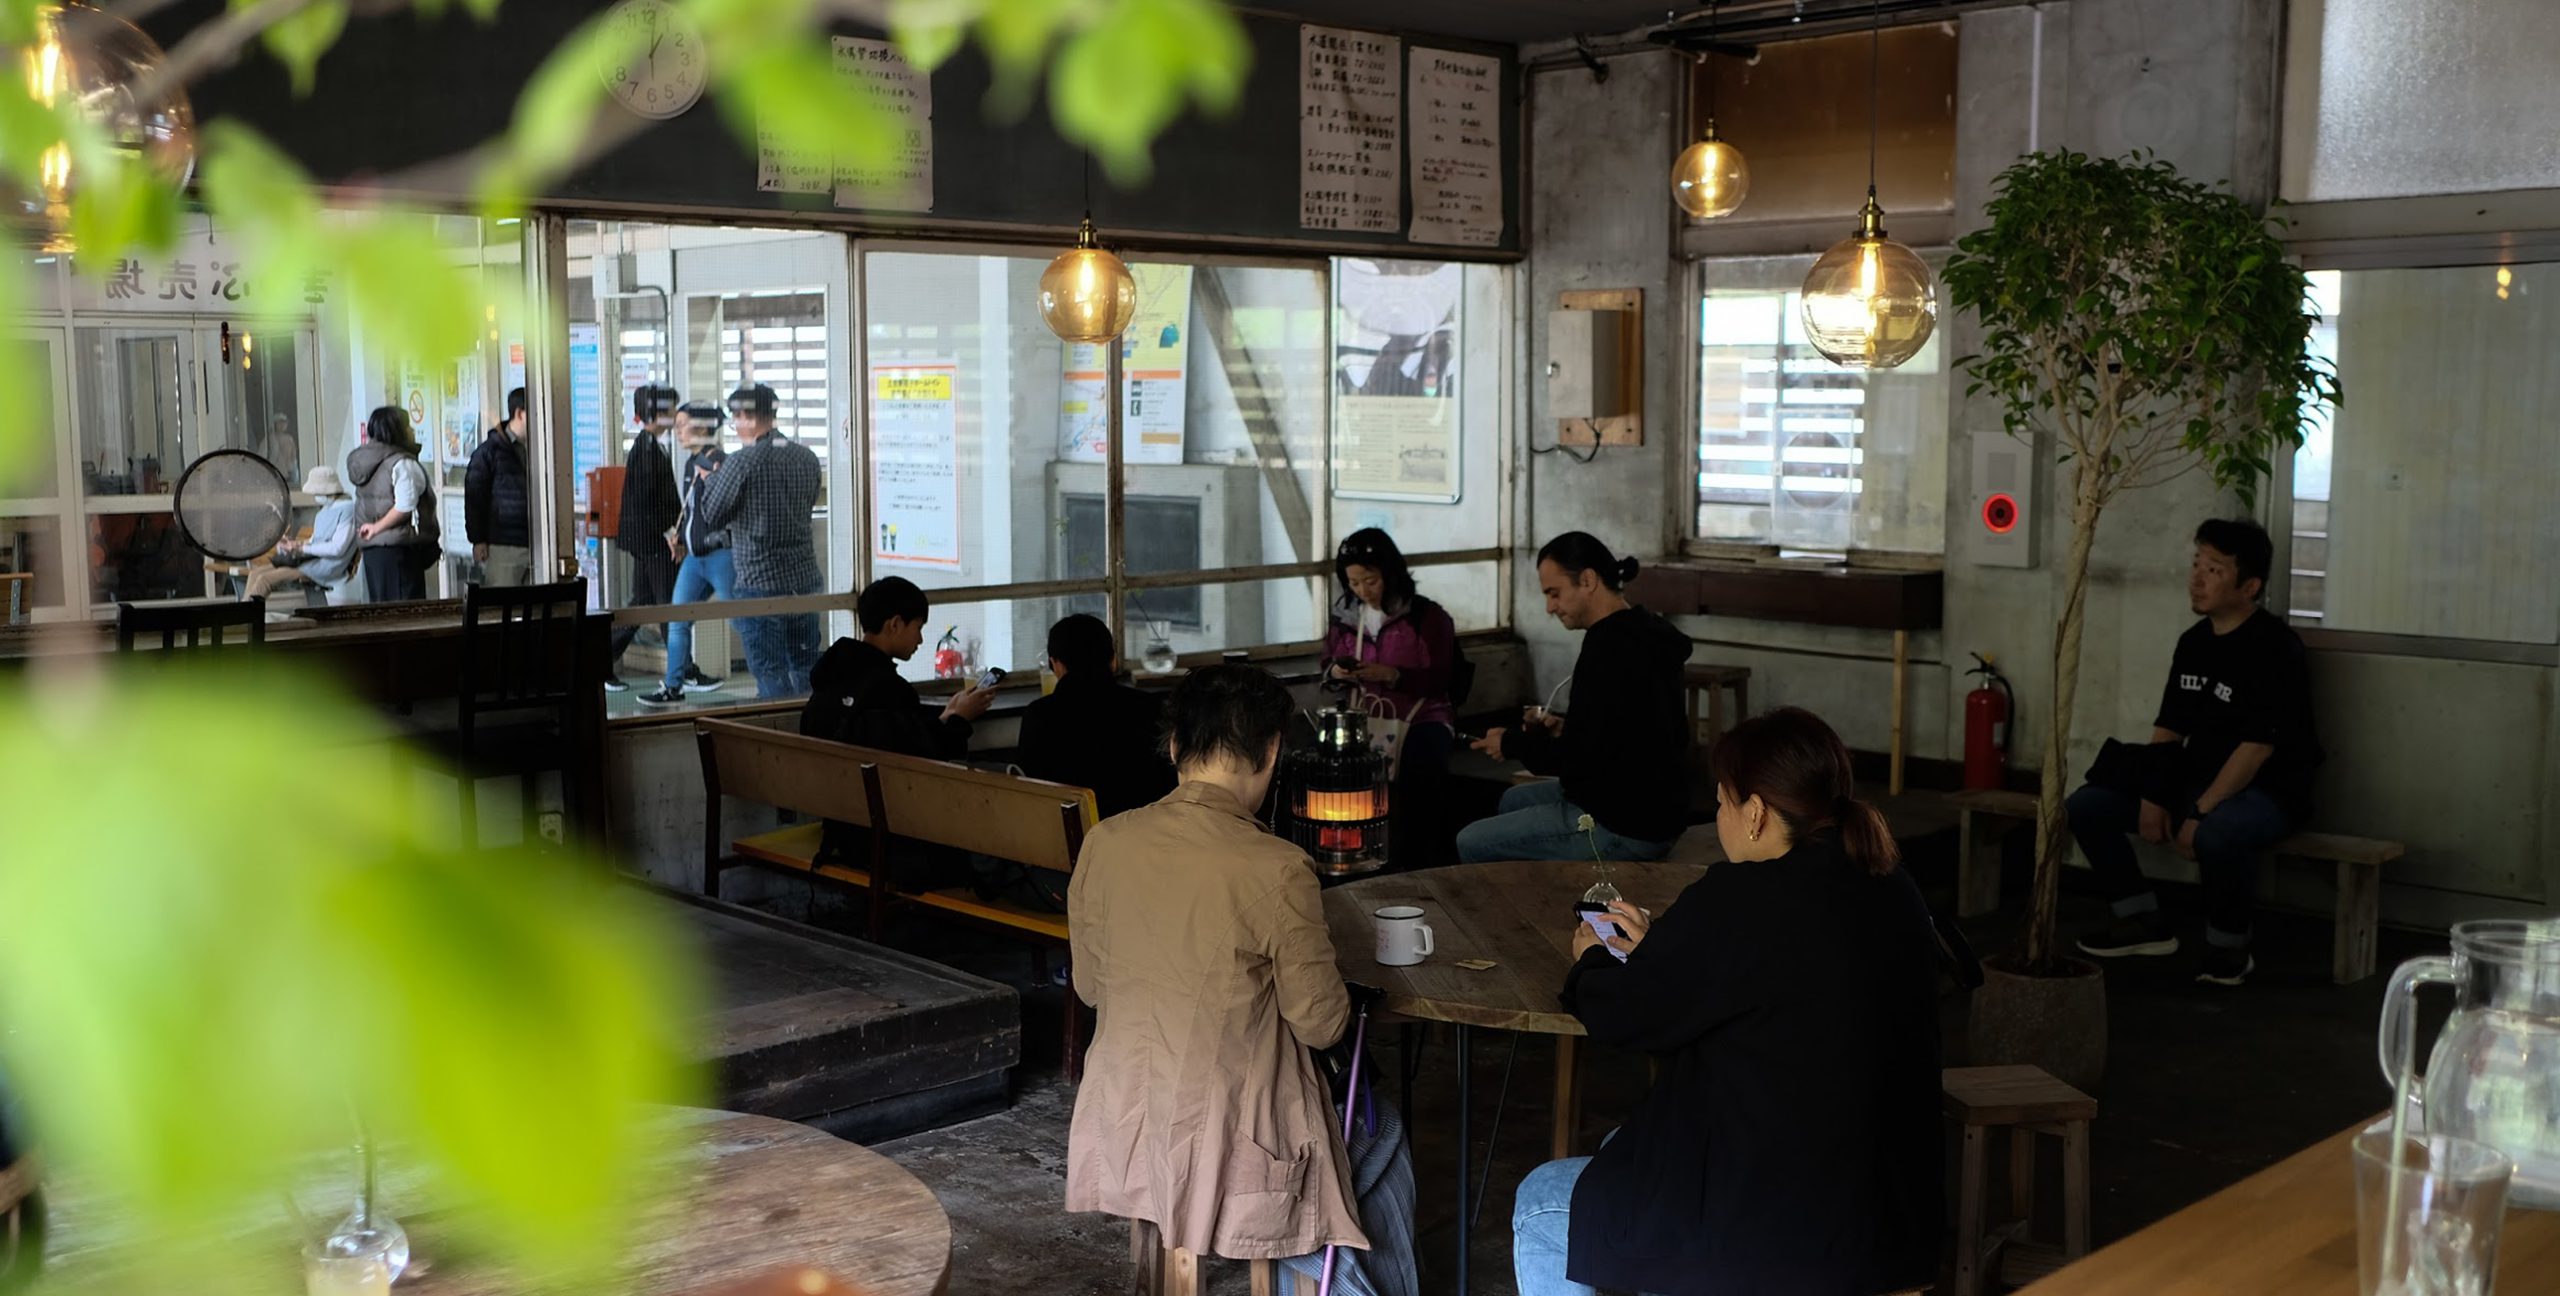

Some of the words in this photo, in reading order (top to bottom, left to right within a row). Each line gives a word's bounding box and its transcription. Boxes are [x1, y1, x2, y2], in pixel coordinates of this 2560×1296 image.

[641, 9, 656, 25] 12
[674, 31, 684, 47] 2
[680, 51, 690, 67] 3
[615, 66, 626, 82] 8
[676, 70, 686, 86] 4
[629, 81, 639, 97] 7
[646, 87, 657, 103] 6
[664, 83, 674, 99] 5
